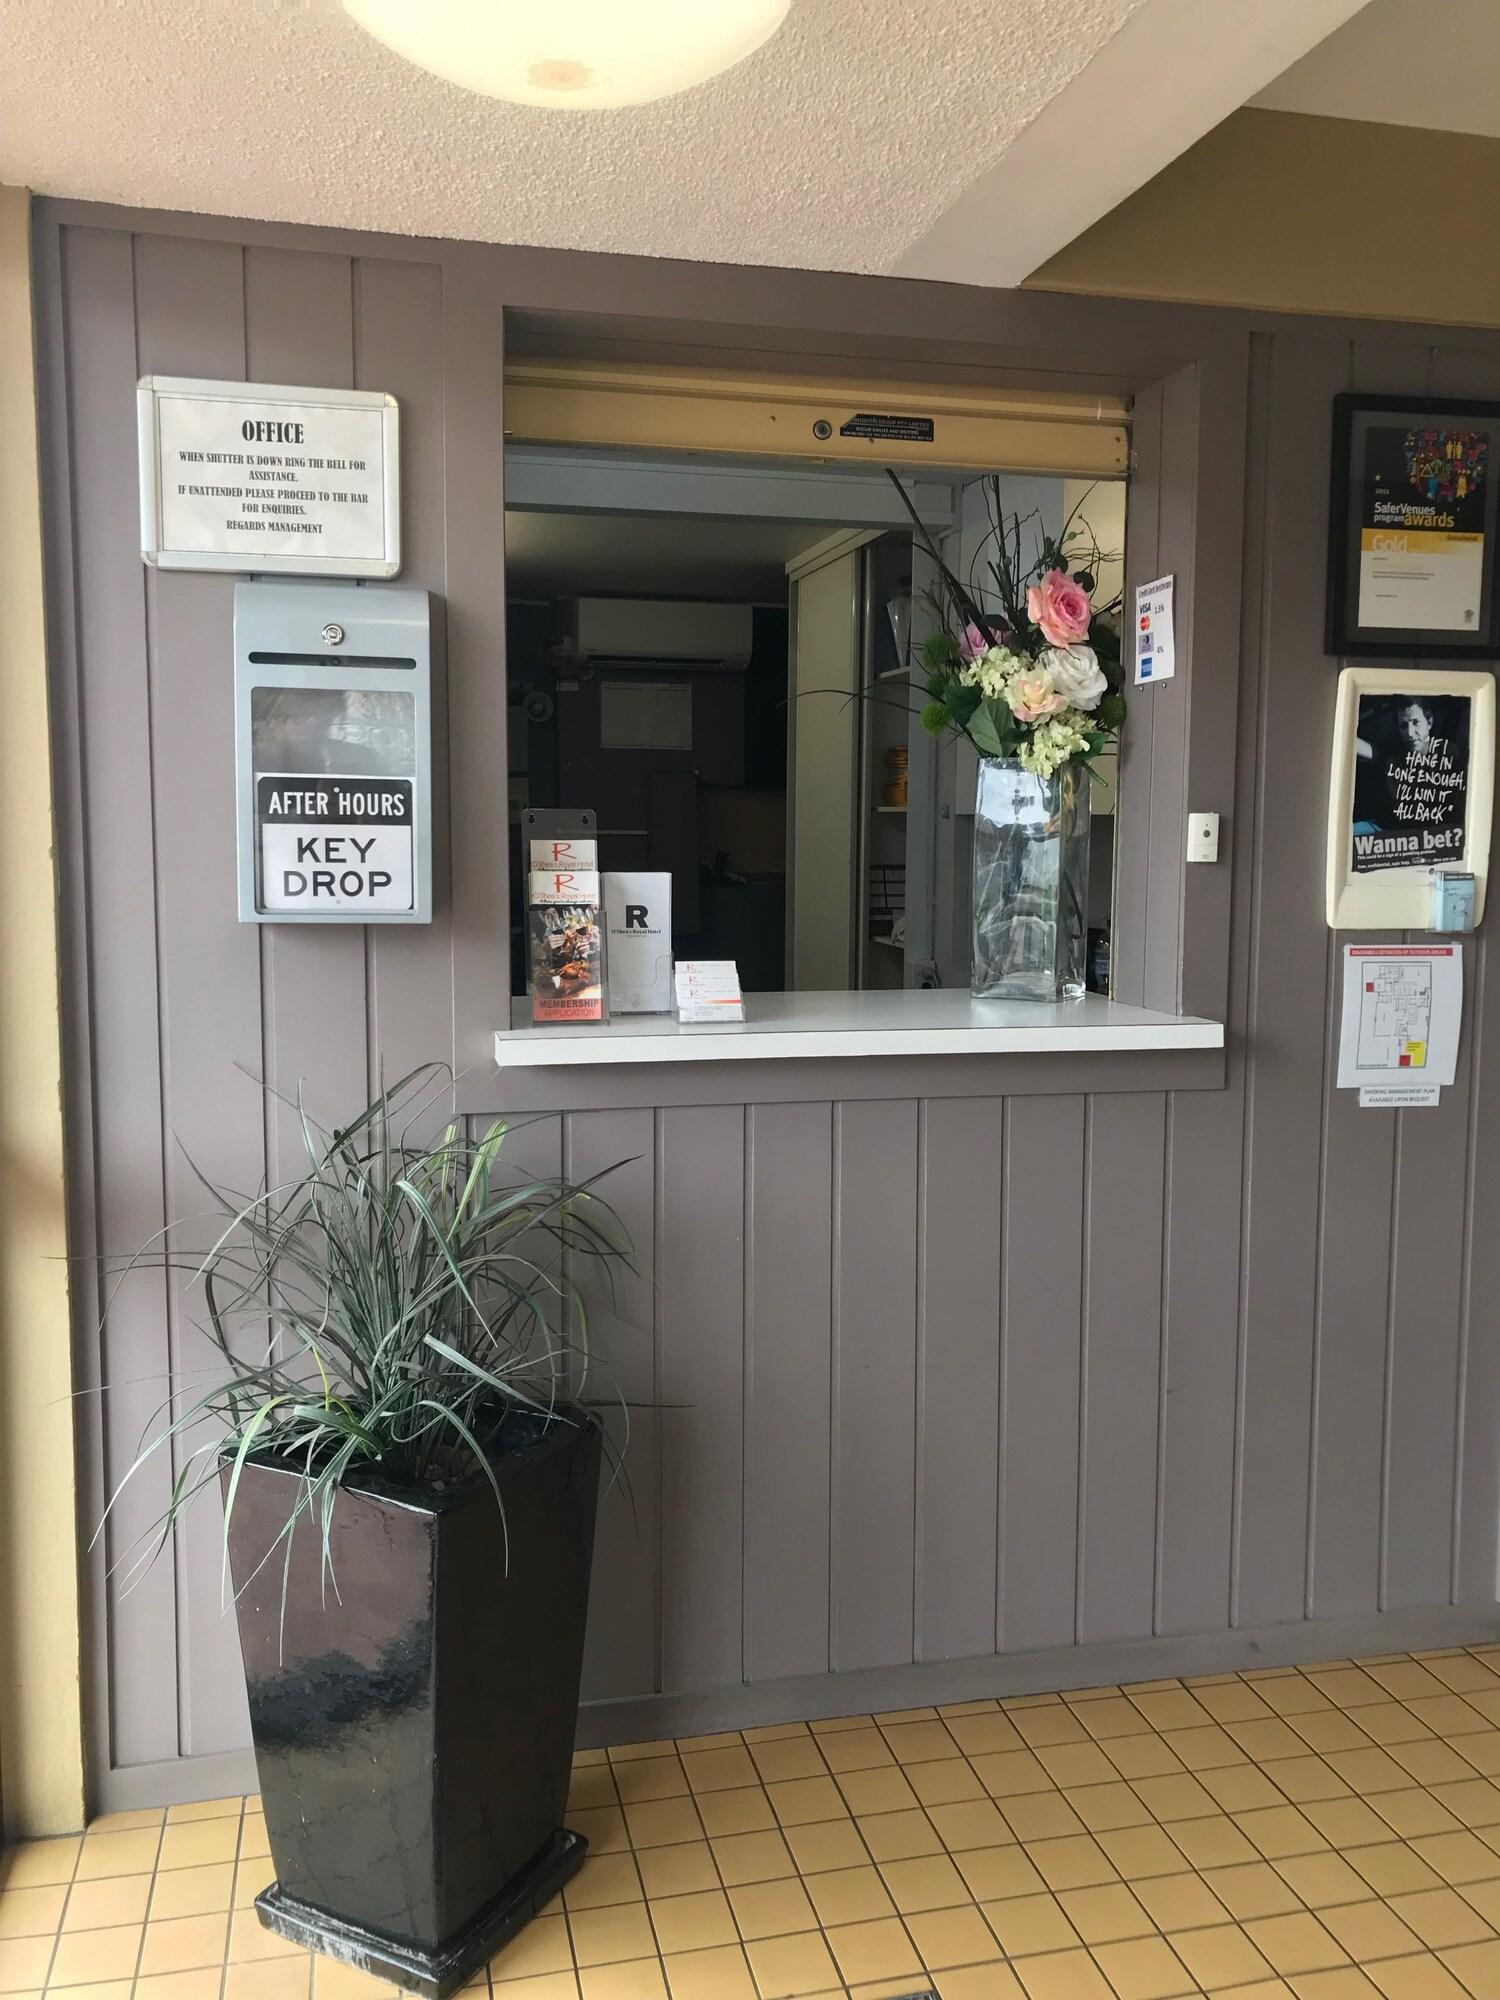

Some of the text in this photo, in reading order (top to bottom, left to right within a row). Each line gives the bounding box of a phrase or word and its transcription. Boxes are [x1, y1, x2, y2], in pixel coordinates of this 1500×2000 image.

[242, 420, 304, 444] OFFICE
[179, 451, 366, 470] WHEN SHUTTER IS DOWN RING THE BELL FOR
[248, 470, 298, 482] ASSISTANCE.
[178, 484, 368, 504] IF UNATTENDED PLEASE PROCEED TO THE BAR
[242, 503, 307, 515] FOR ENQUIRIES.
[226, 520, 322, 534] REGARDS MANAGEMENT
[1372, 534, 1409, 552] Gold
[1140, 602, 1151, 614] VISA
[1443, 739, 1448, 755] I
[1406, 750, 1454, 770] HANG IN
[1388, 763, 1416, 783] LONG
[1414, 786, 1436, 802] WIN
[1439, 790, 1453, 803] IT
[268, 792, 405, 817] AFTER HOURS
[1393, 802, 1414, 820] ALL
[296, 836, 377, 864] KEY
[1354, 828, 1463, 855] Wanna bet?
[552, 842, 576, 862] R
[284, 870, 392, 898] DROP
[554, 874, 580, 893] R
[626, 904, 648, 928] R
[539, 999, 598, 1008] MEMBERSHIP
[544, 1008, 595, 1017] APPLICATION
